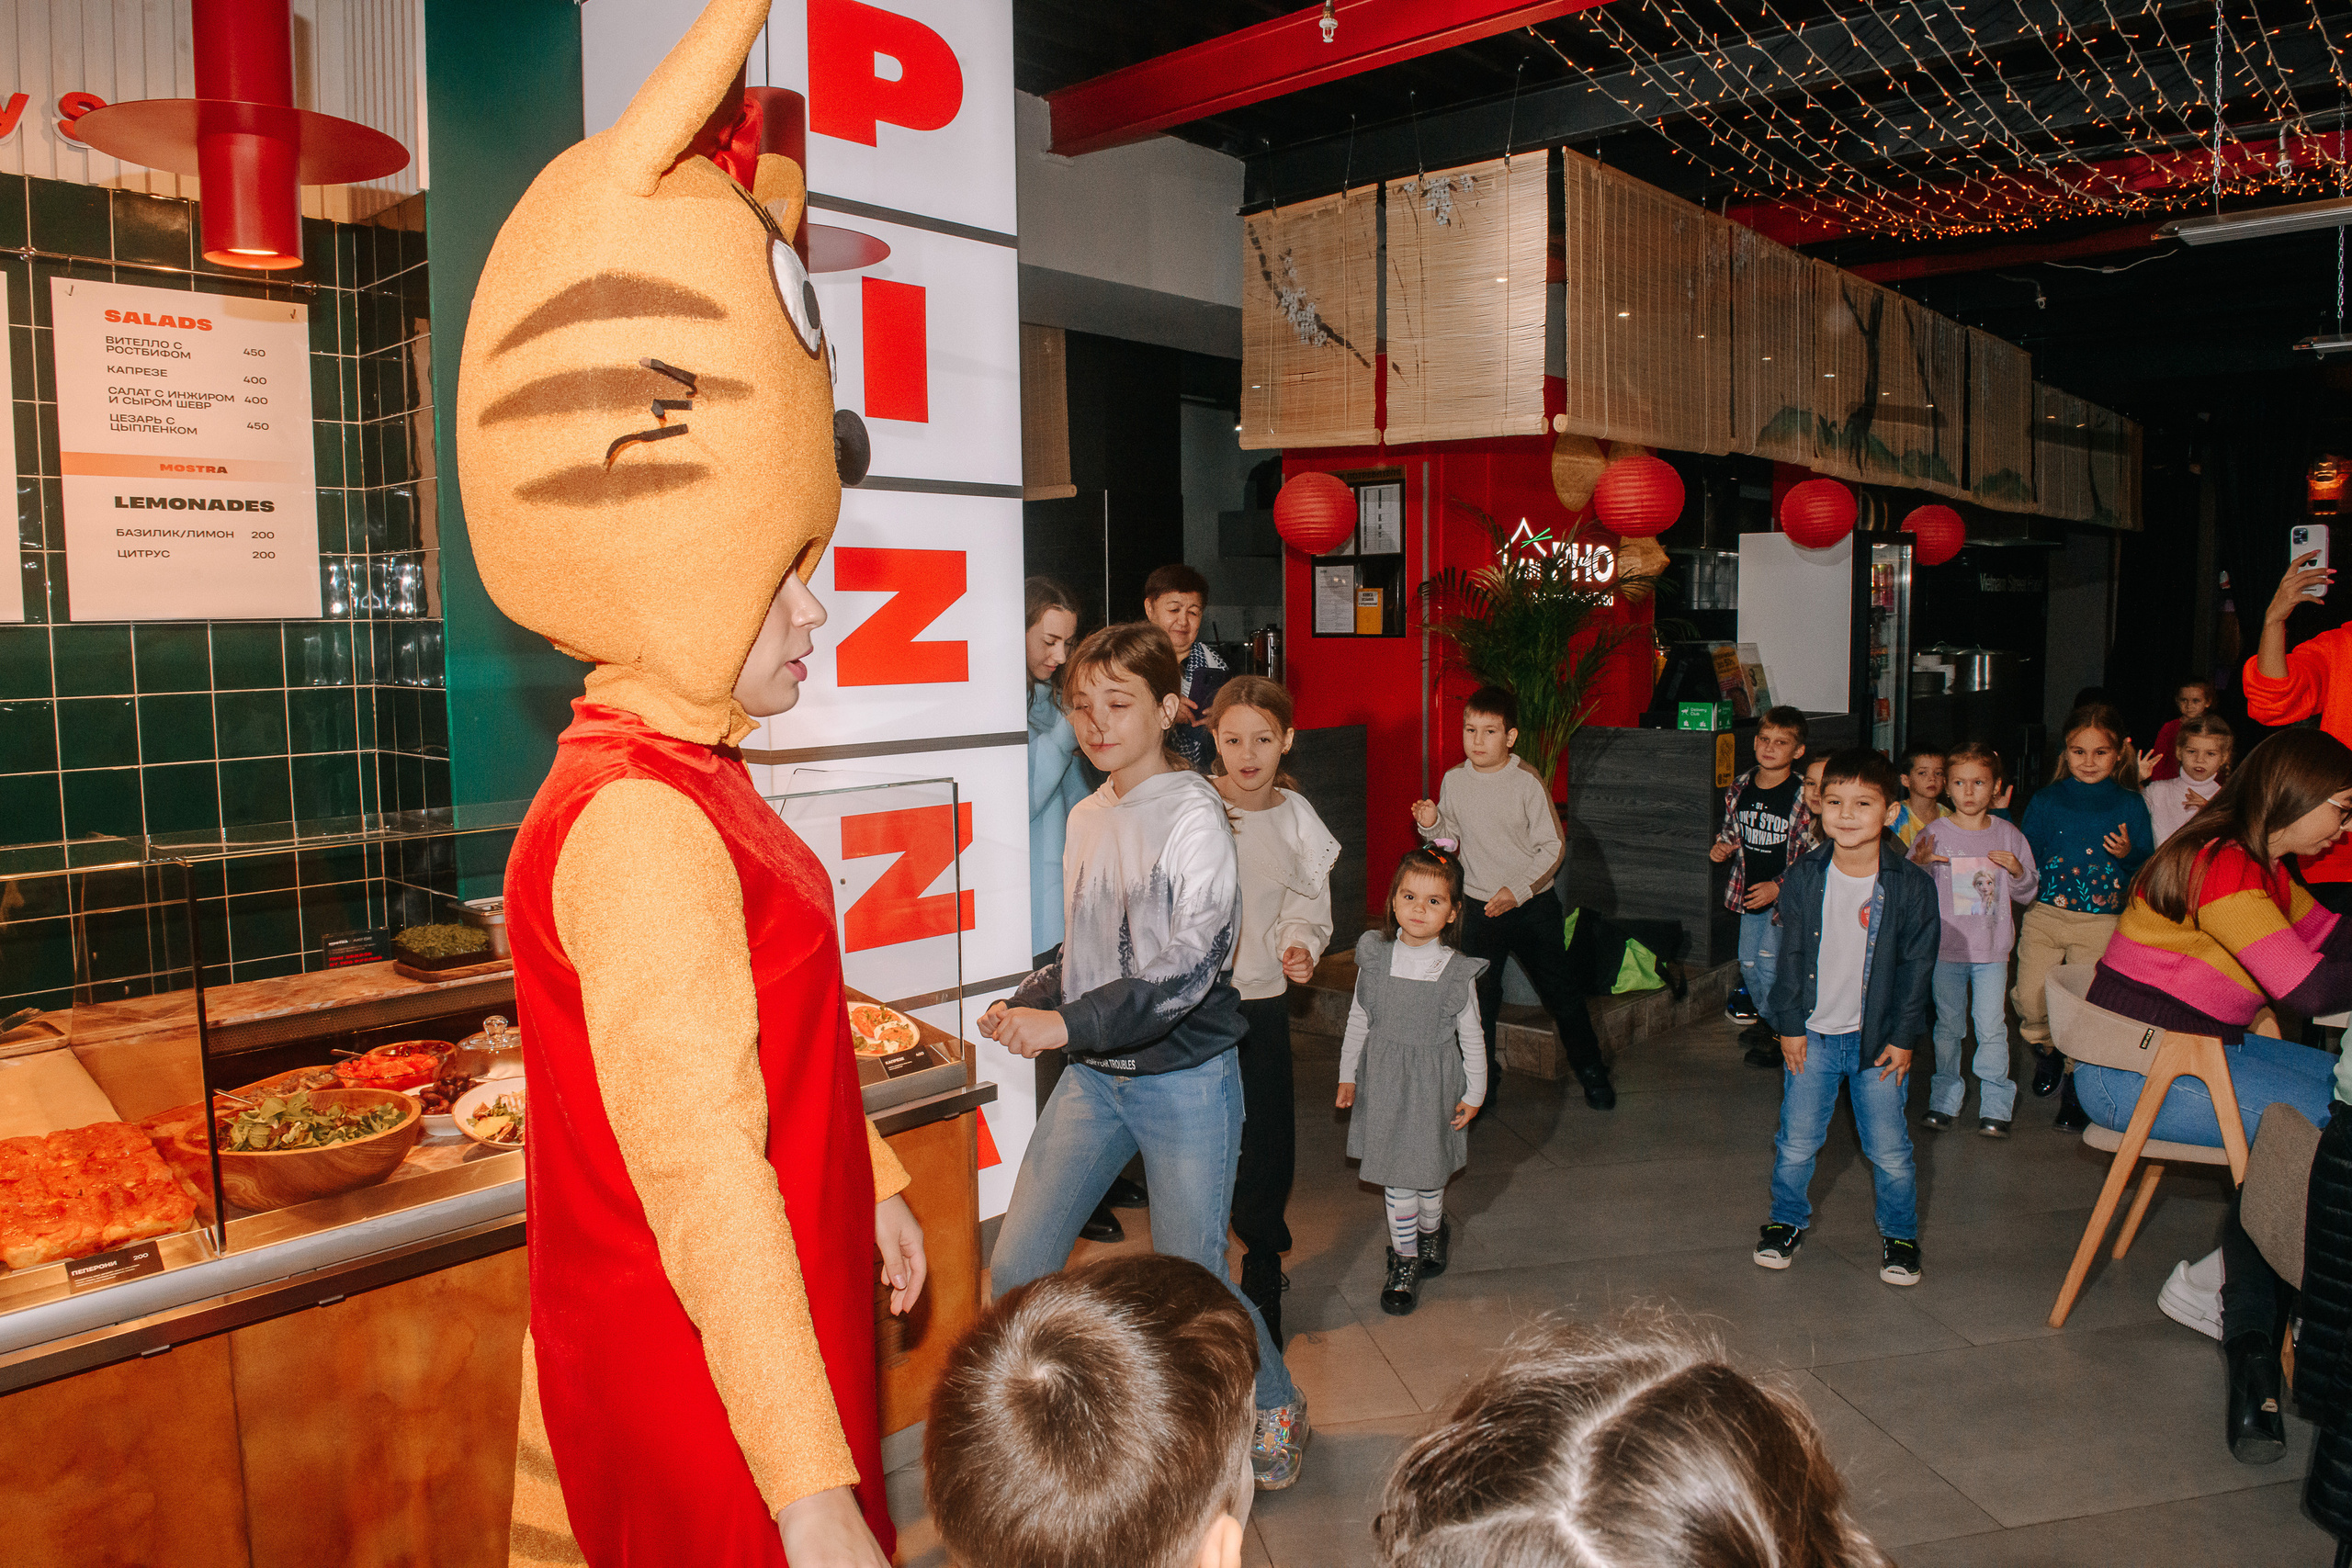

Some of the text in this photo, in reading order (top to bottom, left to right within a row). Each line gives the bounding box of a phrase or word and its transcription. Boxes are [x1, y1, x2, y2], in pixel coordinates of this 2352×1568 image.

[104, 309, 213, 332] SALADS
[106, 335, 183, 350] ВИТЕЛЛО С
[106, 345, 192, 360] РОСТБИФОМ
[243, 347, 266, 358] 450
[107, 365, 168, 378] КАПРЕЗЕ
[243, 376, 267, 386] 400
[107, 387, 235, 402] САЛАТ С ИНЖИРОМ
[108, 396, 212, 410] И СЫРОМ ШЕВР
[243, 396, 268, 406] 400
[109, 413, 175, 426] ЦЕЗАРЬ С
[110, 423, 198, 435] ЦЫПЛЕНКОМ
[246, 422, 270, 431] 450
[160, 463, 228, 474] MOSTRA
[115, 496, 276, 513] LEMONADES
[116, 528, 235, 539] БАЗИЛИК/ЛИМОН
[251, 531, 275, 540] 200
[118, 549, 171, 559] ЦИТРУС
[252, 551, 276, 559] 200
[1759, 812, 1789, 833] STOP
[1108, 1058, 1136, 1070] TROUBLES
[132, 1252, 149, 1261] 200
[71, 1260, 118, 1276] ПЕПЕРОНИ
